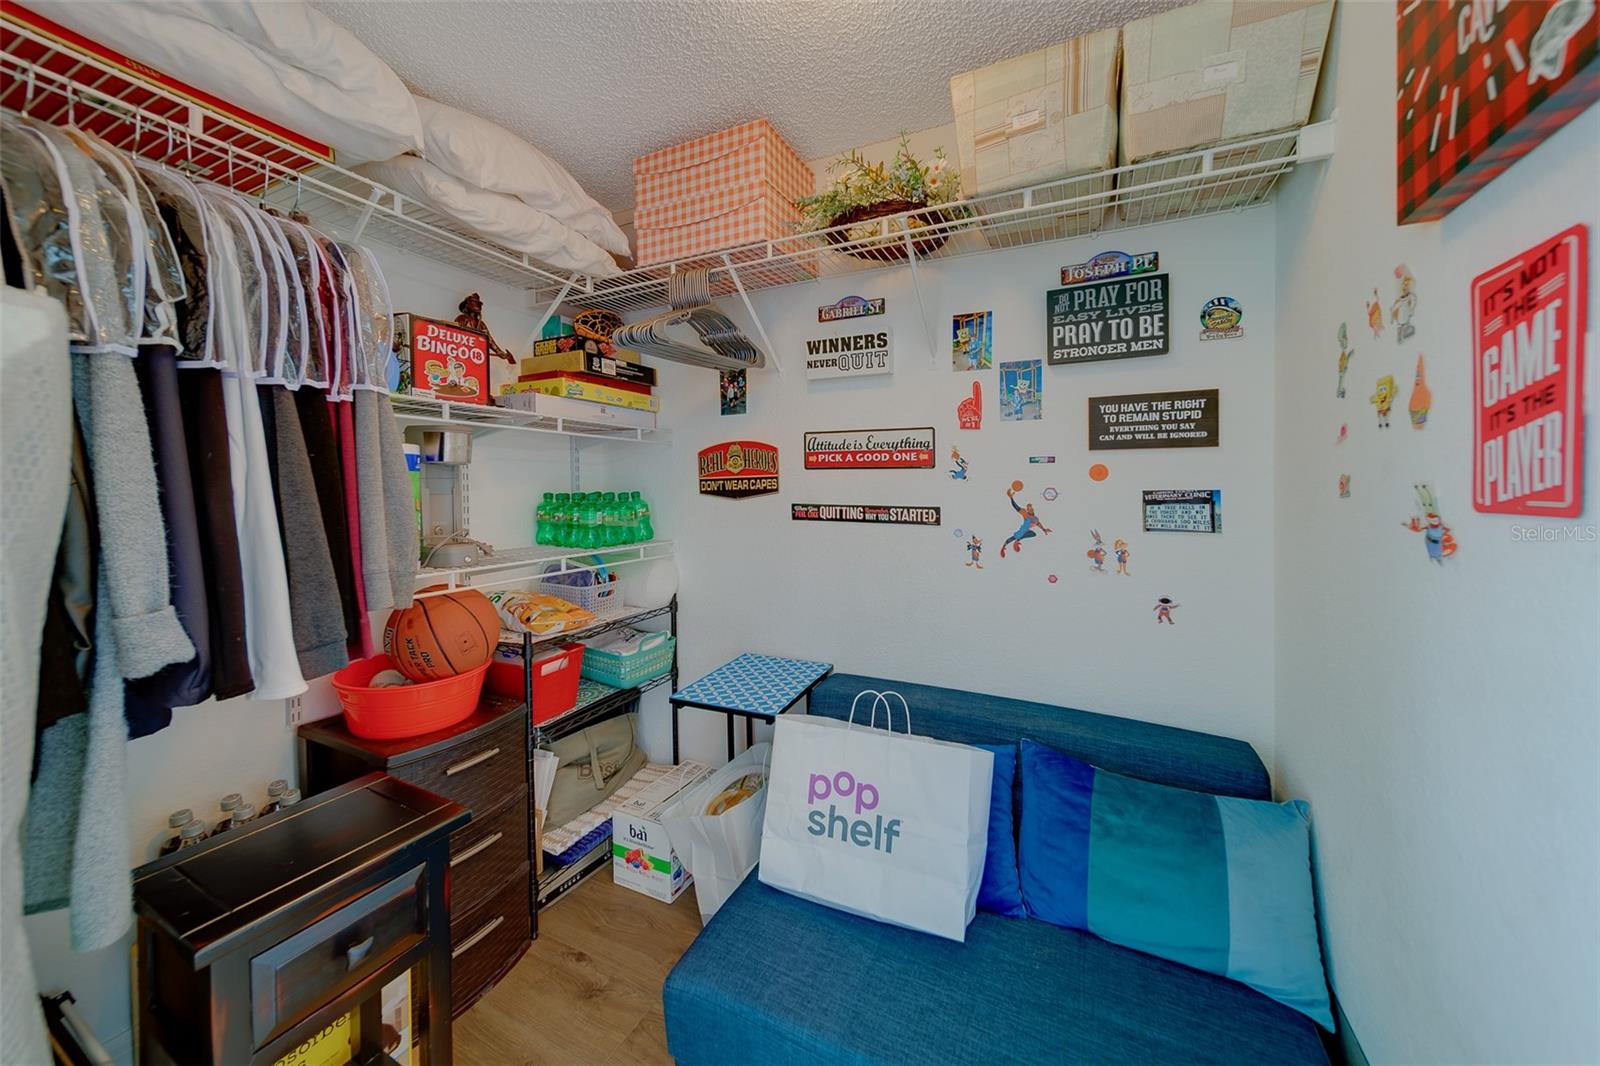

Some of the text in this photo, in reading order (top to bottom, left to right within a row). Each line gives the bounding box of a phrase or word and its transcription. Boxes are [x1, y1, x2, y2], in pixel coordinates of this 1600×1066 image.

[1066, 262, 1126, 282] JOSEPH
[1484, 242, 1562, 316] IT'S NOT
[1074, 279, 1163, 310] PRAY FOR
[822, 304, 866, 320] GABRIEL
[868, 301, 882, 314] ST
[1053, 303, 1164, 324] EASY LIVES
[1054, 303, 1070, 314] NOT
[1503, 287, 1538, 326] THE
[427, 325, 476, 347] DELUXE
[1053, 314, 1165, 347] PRAY TO BE
[416, 335, 469, 360] BINGO
[807, 332, 888, 356] WINNERS
[1053, 339, 1164, 359] STRONGER MEN
[1483, 299, 1562, 408] GAME
[807, 350, 889, 371] NEVER QUIT
[1099, 399, 1207, 414] YOU HAVE THE RIGHT
[1103, 410, 1202, 423] TO REMAIN STUPID
[1490, 384, 1556, 431] IT'S THE
[1109, 424, 1159, 433] EVERYTHING
[1179, 422, 1196, 430] SAY
[1170, 431, 1208, 439] IGNORED
[807, 434, 931, 452] Attitude is Everything
[700, 448, 778, 477] REAL HEROES
[818, 452, 918, 462] PICK A GOOD ONE
[1483, 411, 1562, 506] PLAYER
[701, 479, 778, 491] DON'T WEAR CAPES
[820, 506, 937, 522] QUITTING STARTED
[420, 651, 435, 668] PRO
[807, 771, 879, 815] pop
[629, 823, 648, 842] bai
[807, 804, 901, 854] shelf
